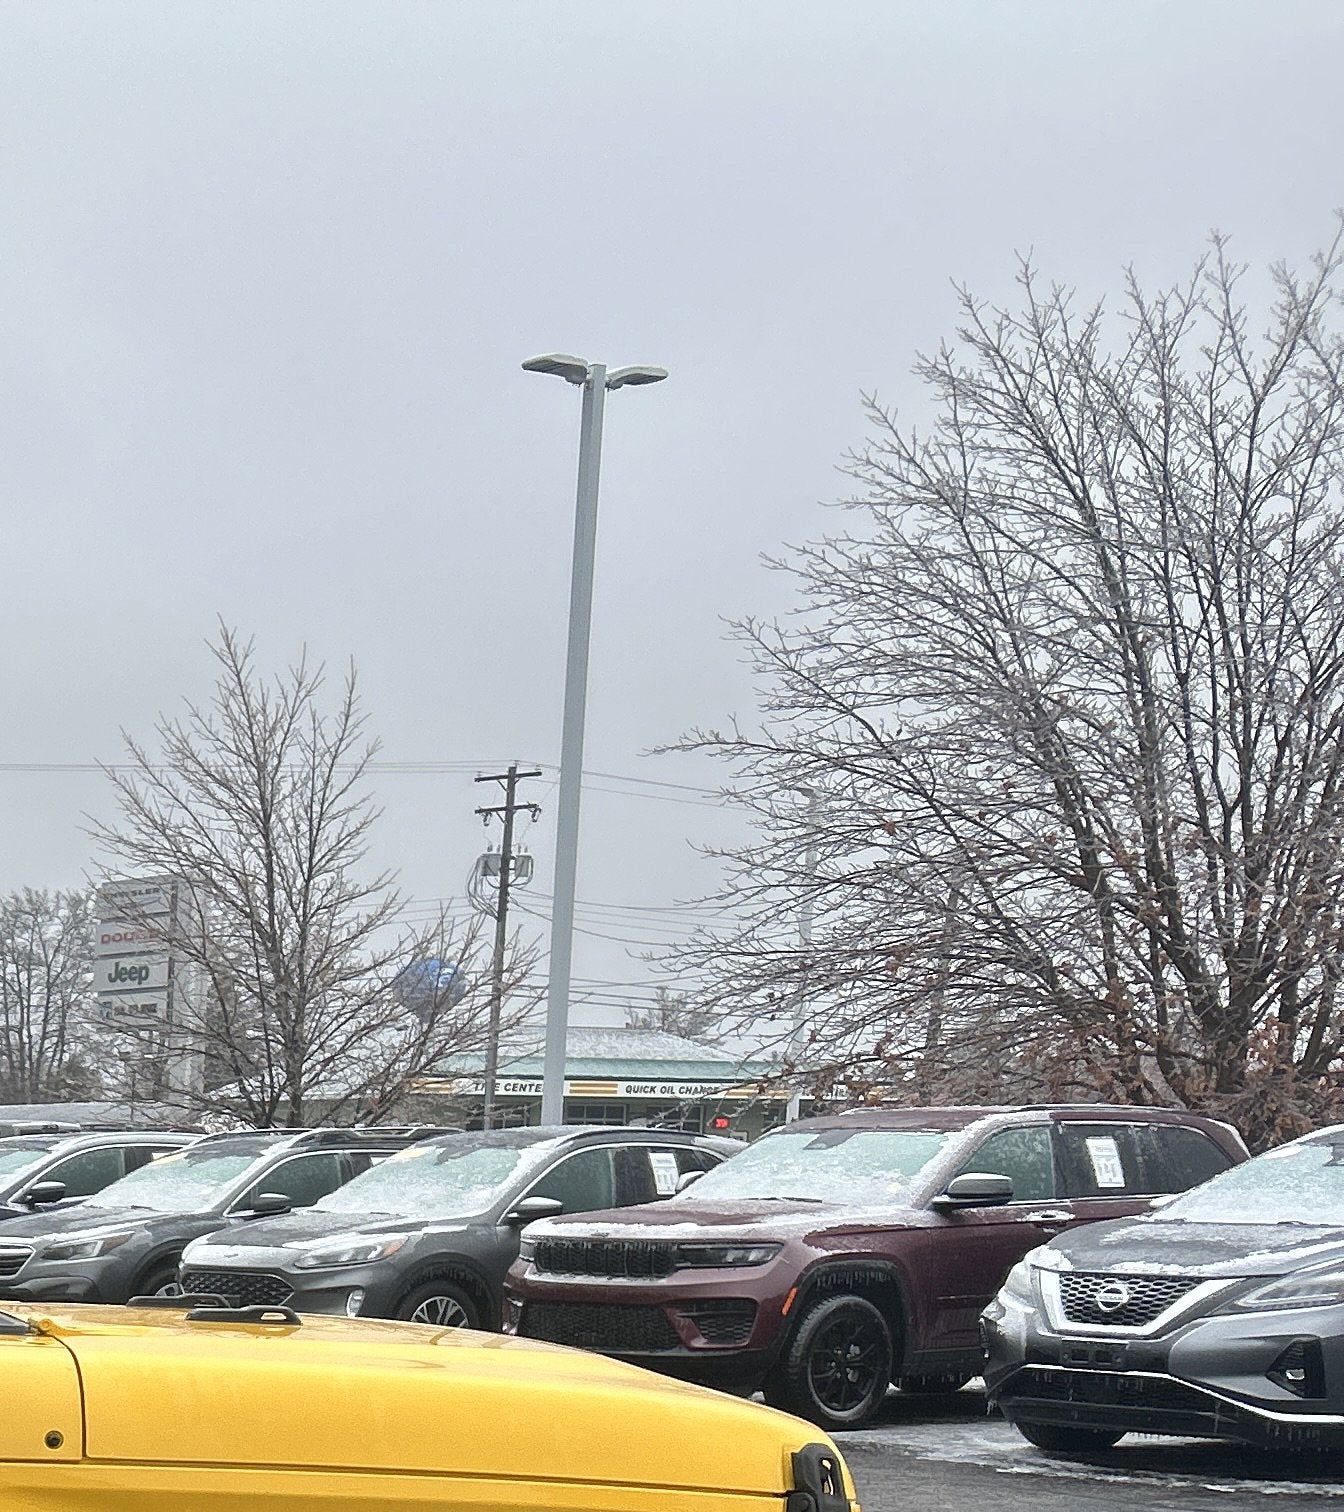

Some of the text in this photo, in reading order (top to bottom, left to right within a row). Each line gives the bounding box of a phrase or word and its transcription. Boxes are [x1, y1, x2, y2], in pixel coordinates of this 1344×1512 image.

[107, 961, 150, 985] Jeep
[503, 1082, 543, 1093] CENTE
[625, 1084, 657, 1095] QUICK
[659, 1085, 676, 1095] OIL
